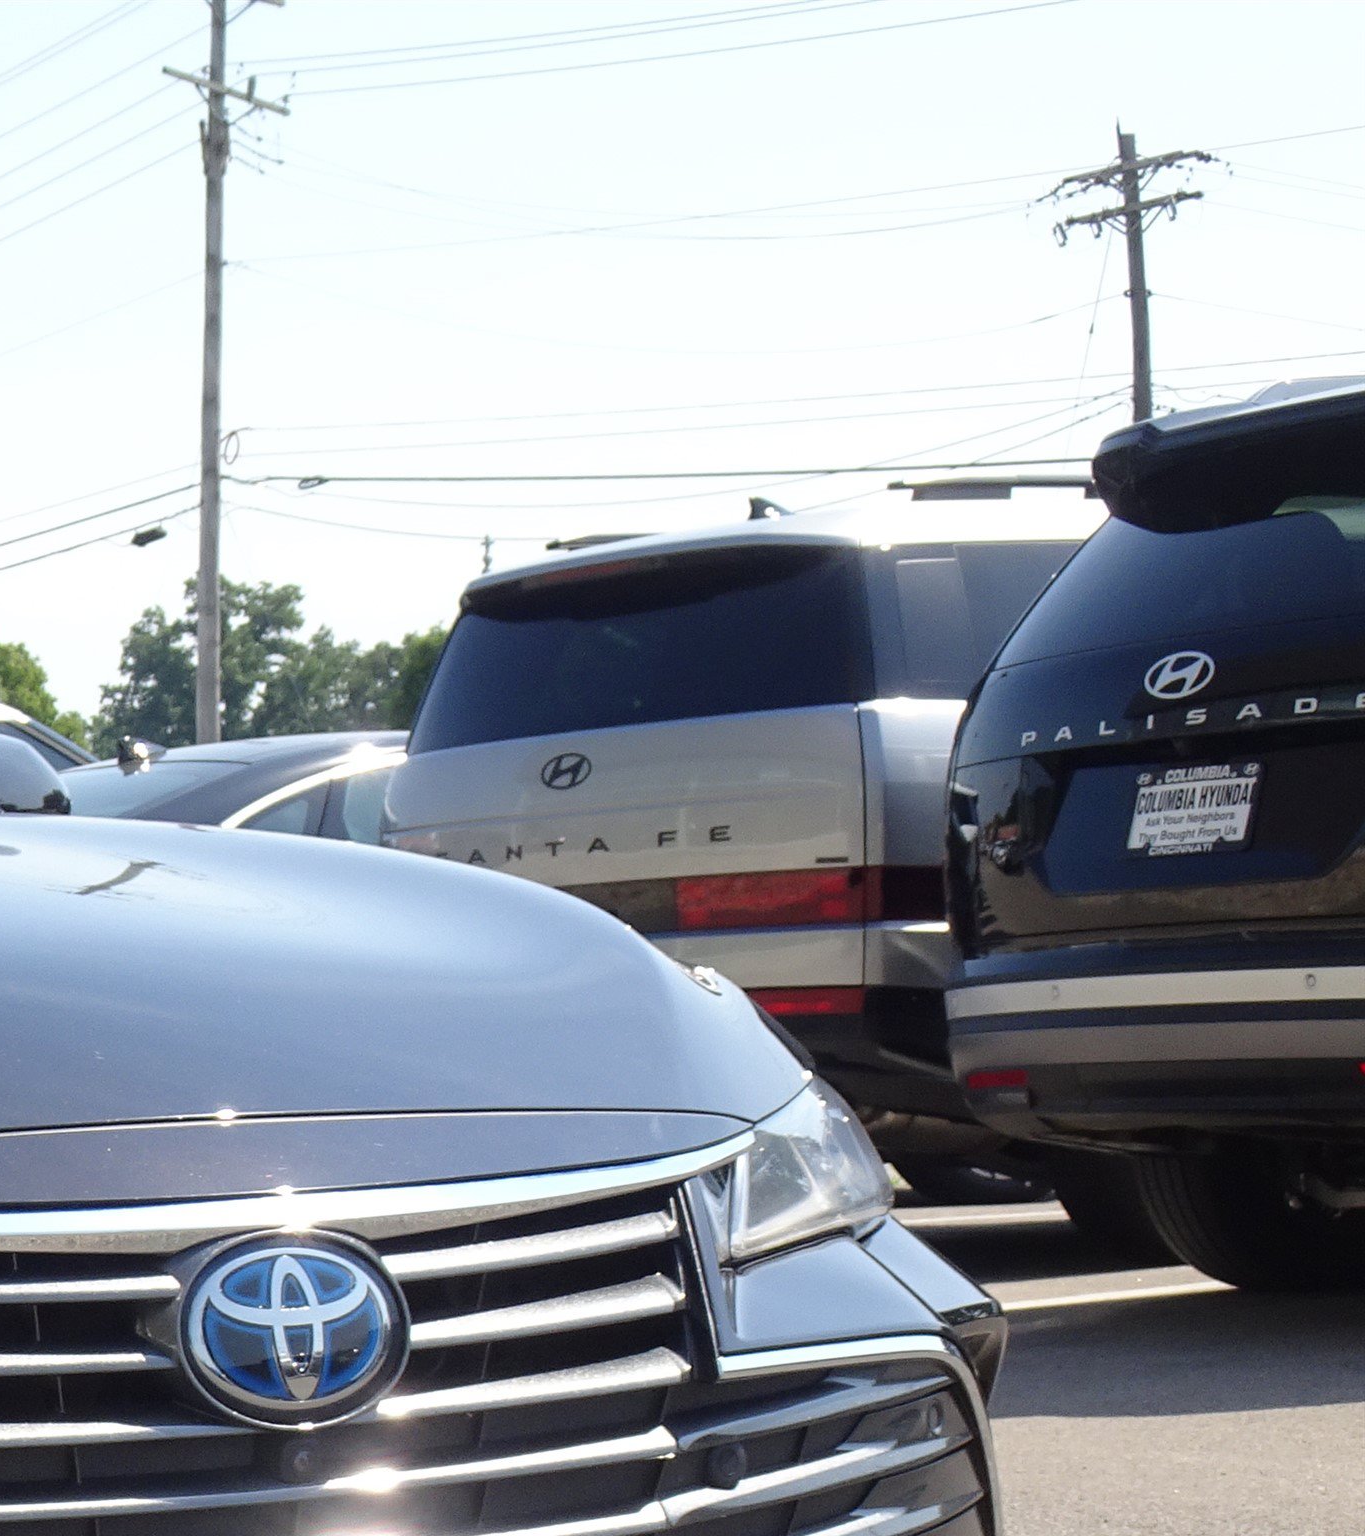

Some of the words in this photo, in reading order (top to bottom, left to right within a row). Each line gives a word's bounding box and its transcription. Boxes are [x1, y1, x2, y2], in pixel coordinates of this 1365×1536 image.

[1165, 765, 1230, 783] COLUMBIA
[1137, 788, 1196, 814] COLUMBIA
[1146, 817, 1160, 826] Ask
[1162, 815, 1183, 826] Your
[1186, 811, 1235, 825] Neighbors
[657, 825, 732, 848] FE
[1160, 828, 1195, 842] Bought
[1197, 827, 1221, 838] From
[1224, 825, 1237, 836] Us
[1149, 844, 1212, 856] CINCINNATI
